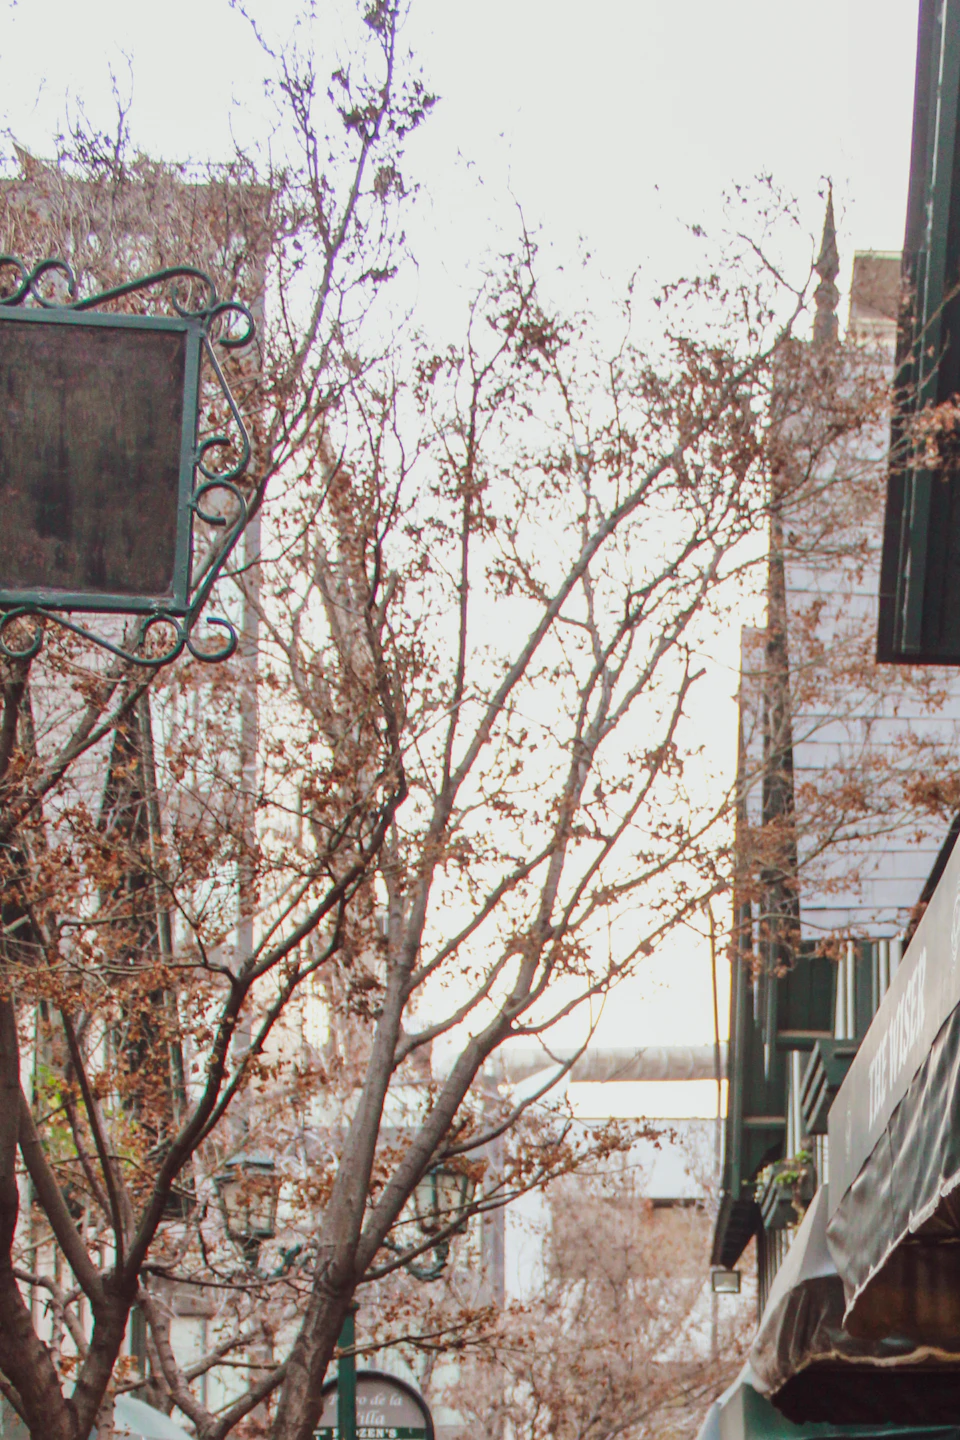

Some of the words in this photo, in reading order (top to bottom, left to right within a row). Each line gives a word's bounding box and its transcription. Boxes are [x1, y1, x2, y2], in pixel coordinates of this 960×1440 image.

[868, 1029, 888, 1132] THE
[889, 946, 927, 1092] WISER
[356, 1410, 386, 1426] illa
